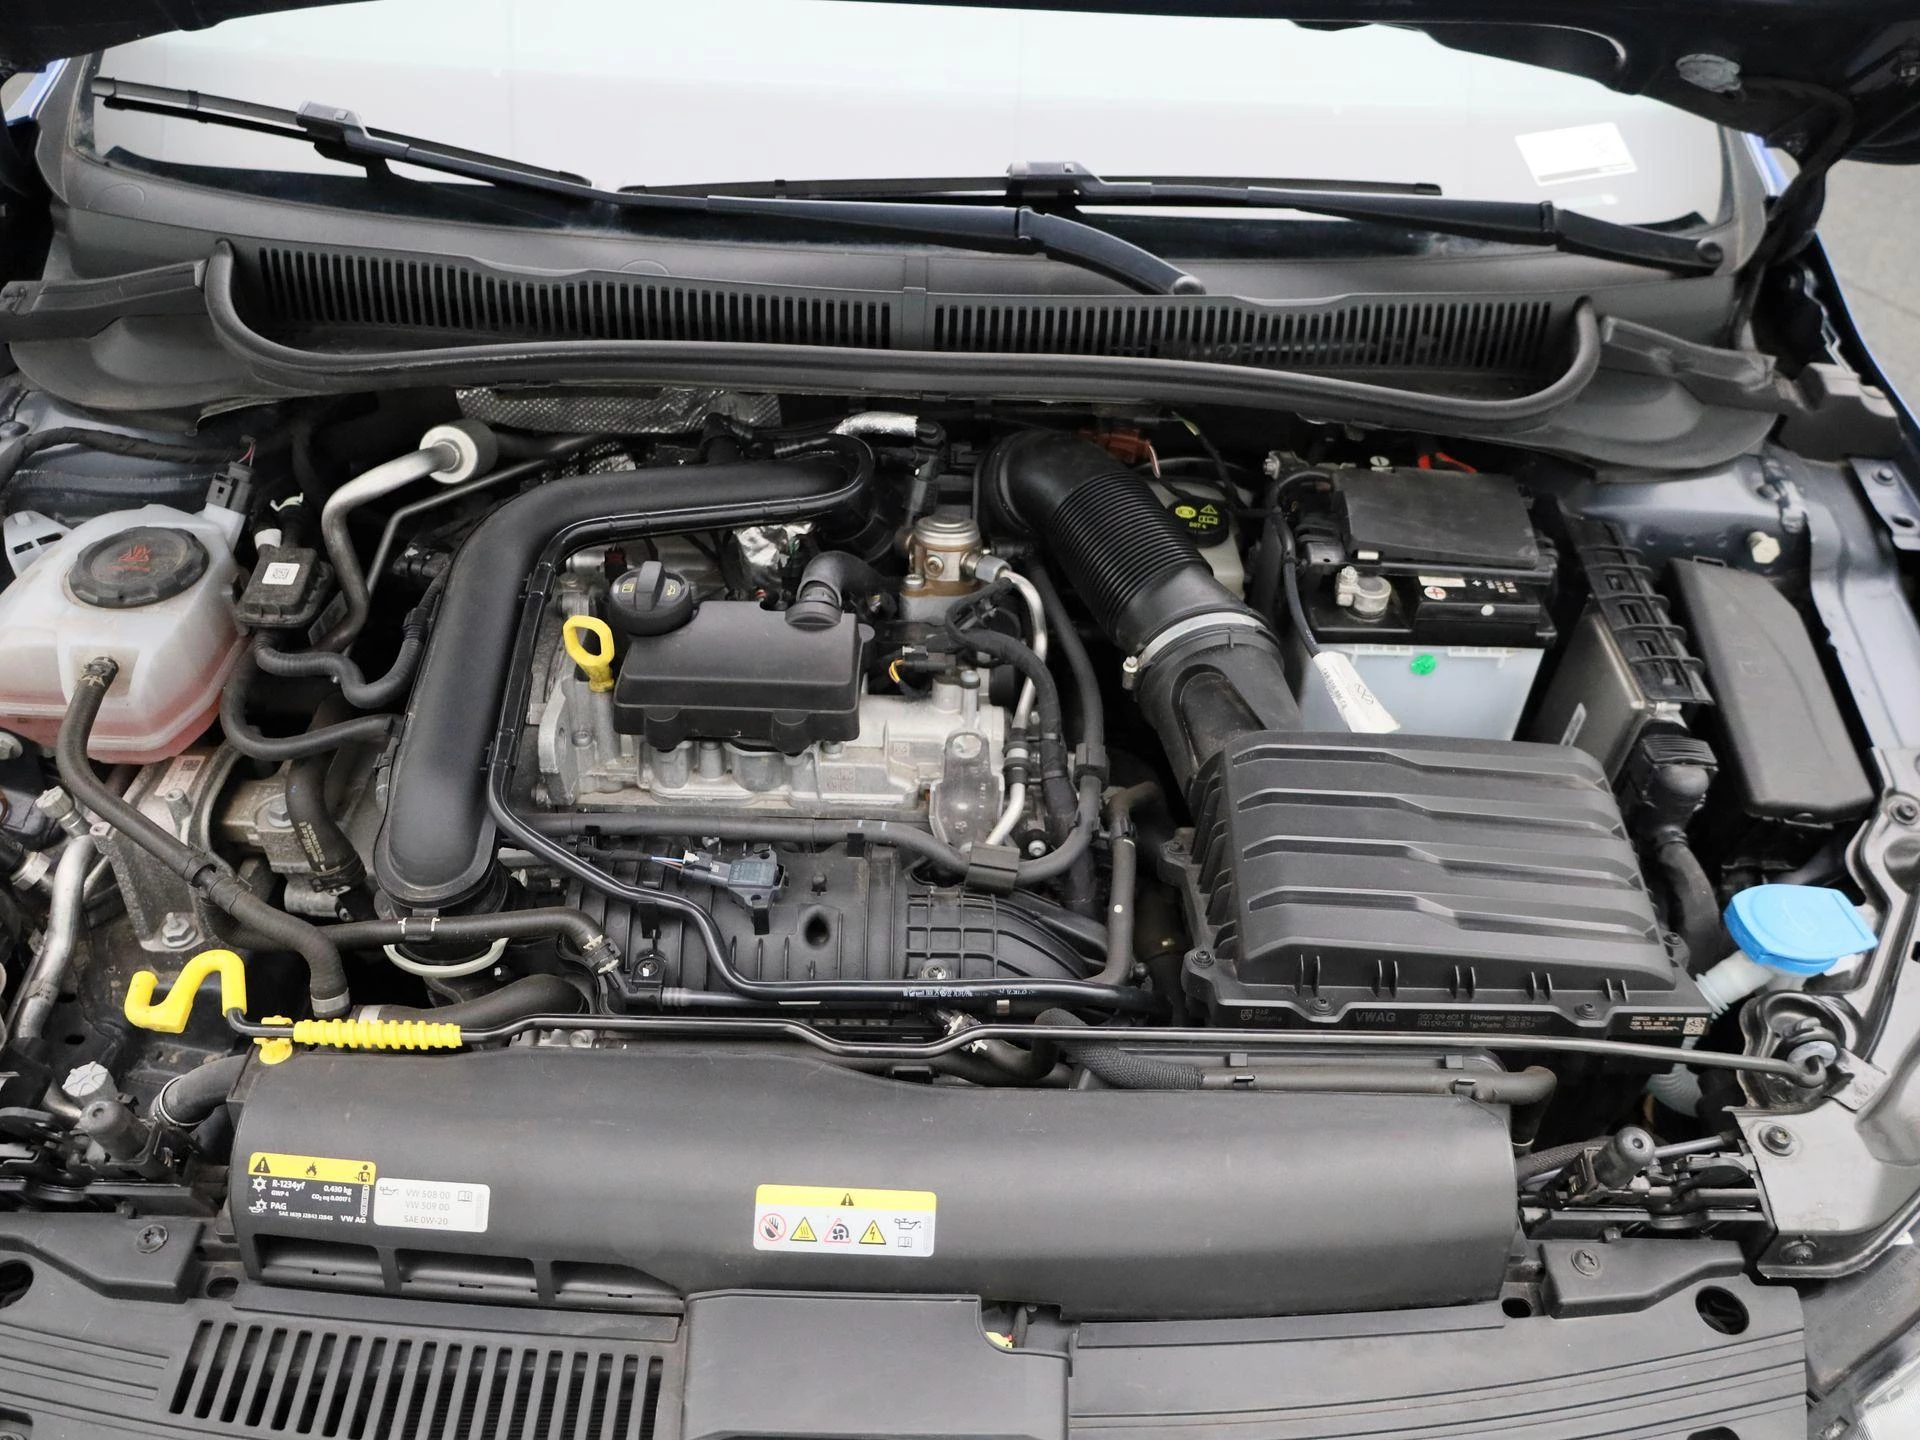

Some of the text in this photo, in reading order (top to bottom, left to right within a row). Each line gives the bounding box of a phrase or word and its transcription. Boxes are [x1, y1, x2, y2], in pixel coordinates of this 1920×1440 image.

[272, 1179, 306, 1191] R-1234yf
[406, 1188, 450, 1200] VW 508 00
[270, 1201, 287, 1210] PAG
[405, 1200, 450, 1211] VW 509 00
[340, 1215, 367, 1224] VW AG
[404, 1215, 448, 1225] SAE 0W-20
